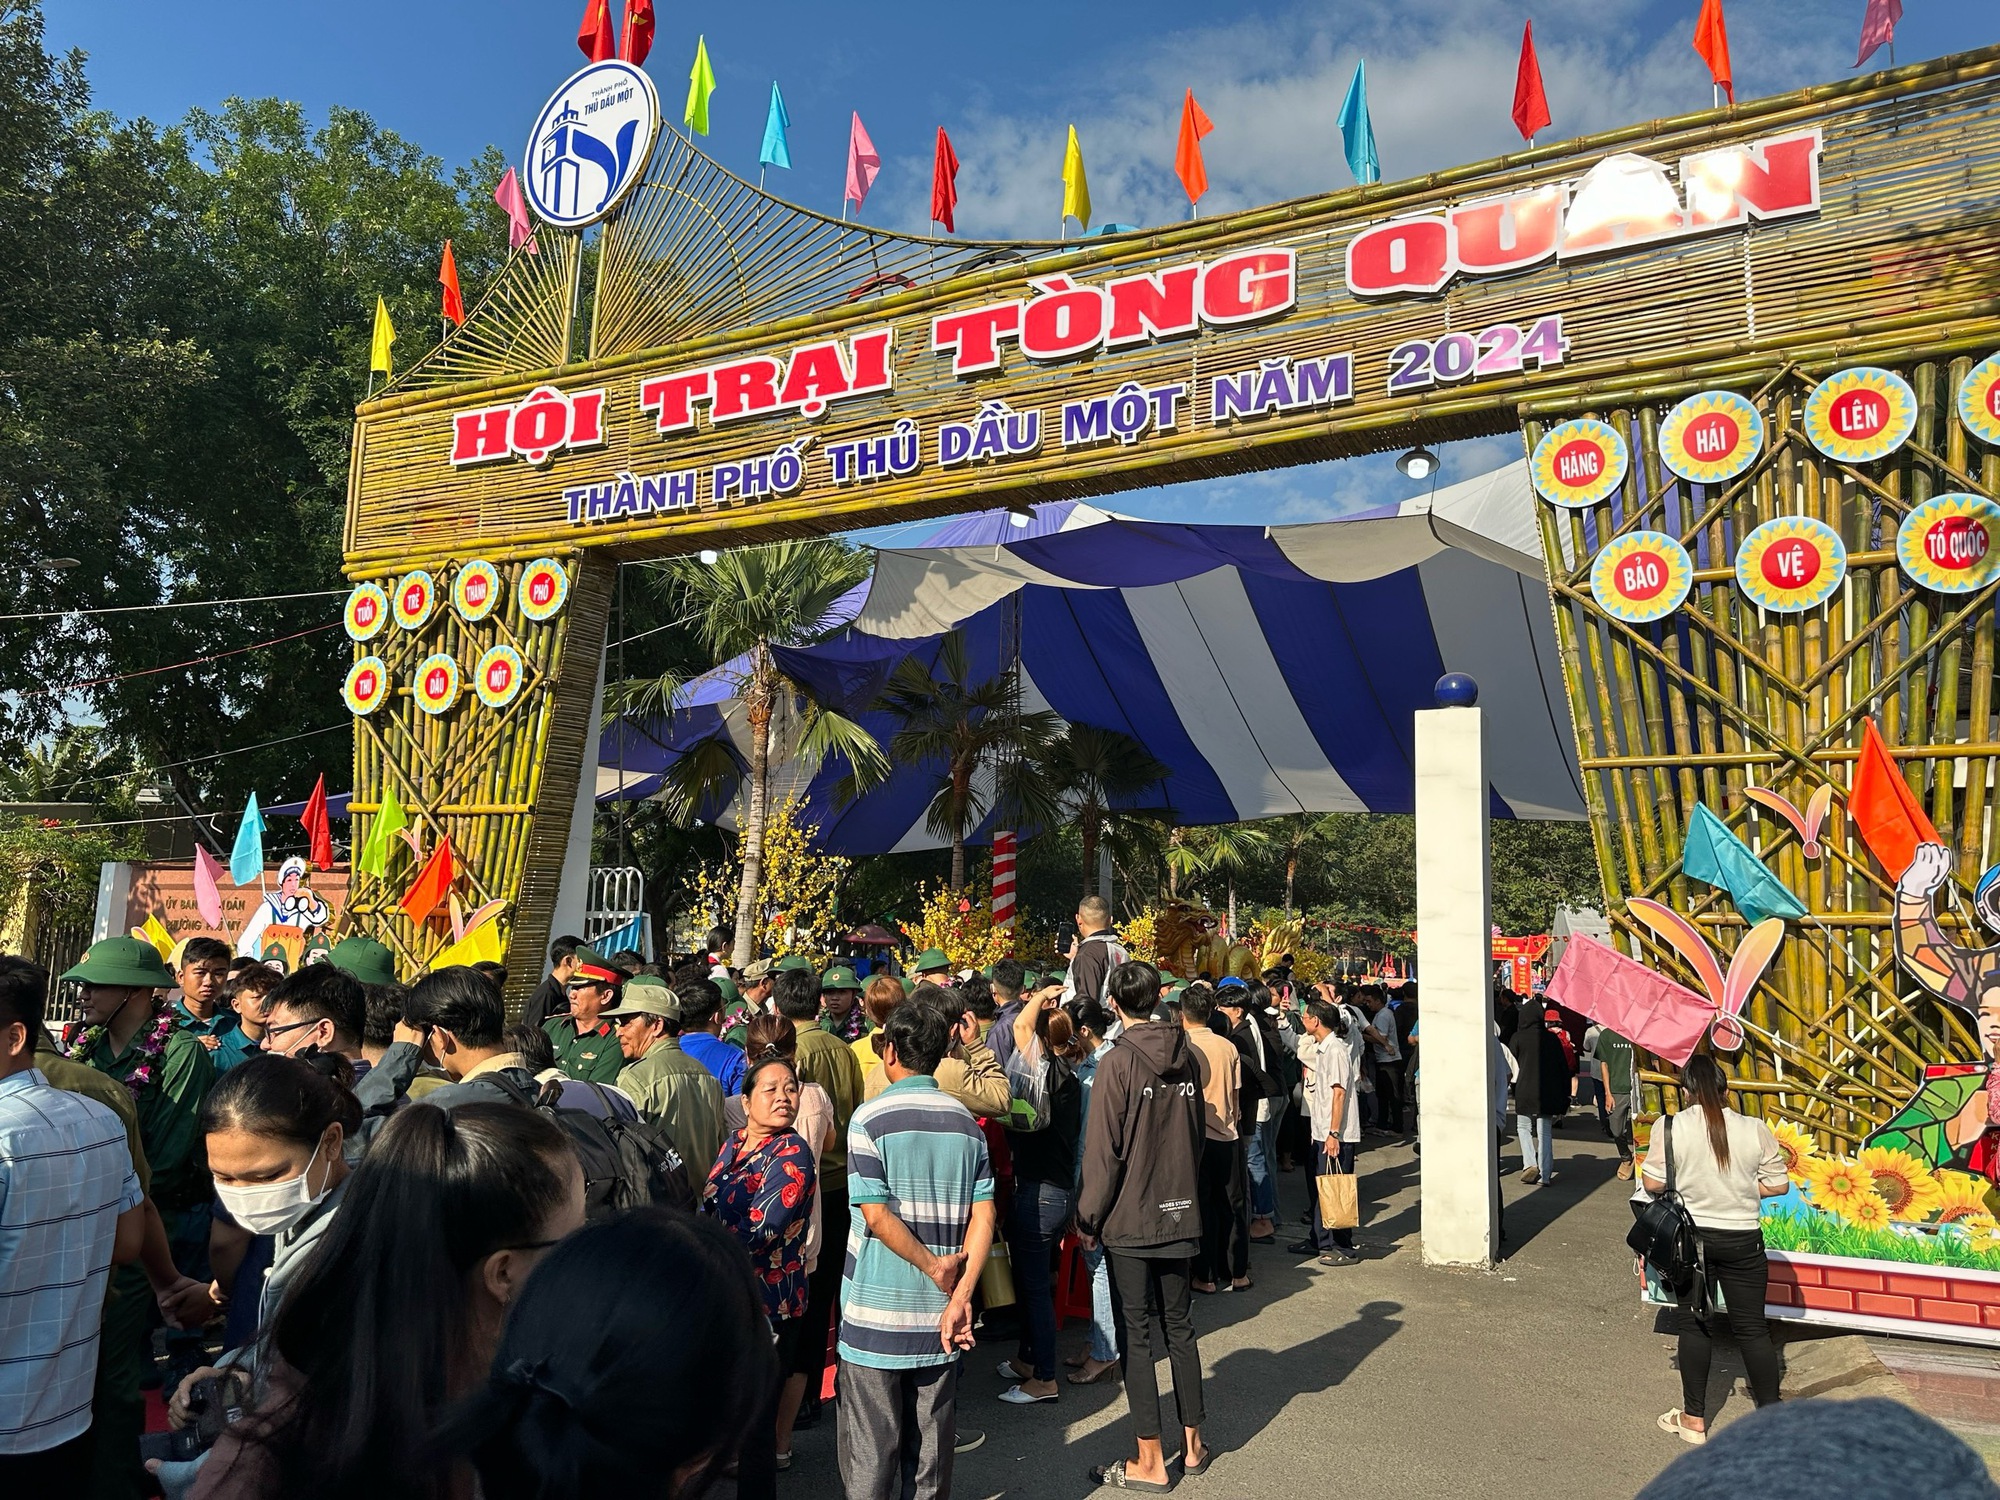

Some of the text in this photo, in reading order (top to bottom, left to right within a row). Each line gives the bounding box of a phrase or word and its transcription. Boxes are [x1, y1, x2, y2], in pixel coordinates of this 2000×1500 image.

[614, 77, 628, 89] PHỐ
[585, 98, 599, 115] THỦ
[617, 87, 634, 103] MỘT
[451, 386, 606, 466] HỘI
[641, 328, 895, 419] TRẠI
[932, 248, 1297, 375] TÒNG
[563, 313, 1570, 524] THÀNH PHỐ THỦ DẦU MỘT NĂM 2024
[1841, 399, 1878, 432] LÊN
[1695, 421, 1727, 454] HÁI
[1560, 449, 1598, 481] HĂNG
[1928, 520, 1986, 562] TỔ QUỐC
[1623, 556, 1659, 592] BẢO
[1777, 546, 1805, 582] VỆ
[407, 588, 420, 610] TRẺ
[533, 577, 551, 601] PHỐ
[165, 896, 178, 909] ỦY
[180, 899, 198, 910] BAN
[226, 897, 246, 911] DÂN
